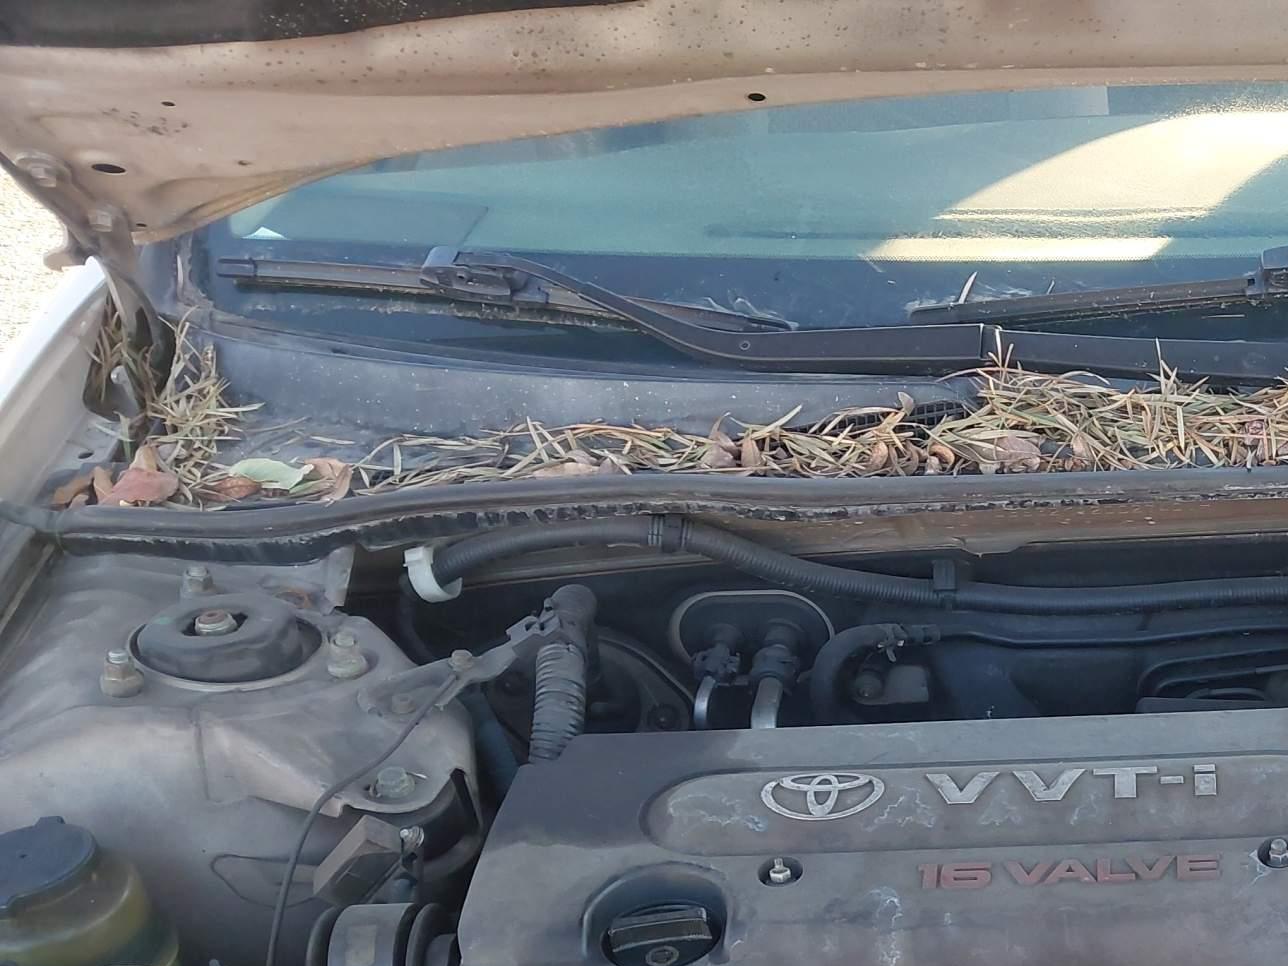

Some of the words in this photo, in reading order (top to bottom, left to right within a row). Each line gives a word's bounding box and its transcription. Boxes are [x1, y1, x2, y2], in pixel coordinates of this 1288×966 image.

[924, 763, 1218, 804] VVT-i
[917, 861, 994, 890] 16
[1007, 854, 1225, 886] VALVE
